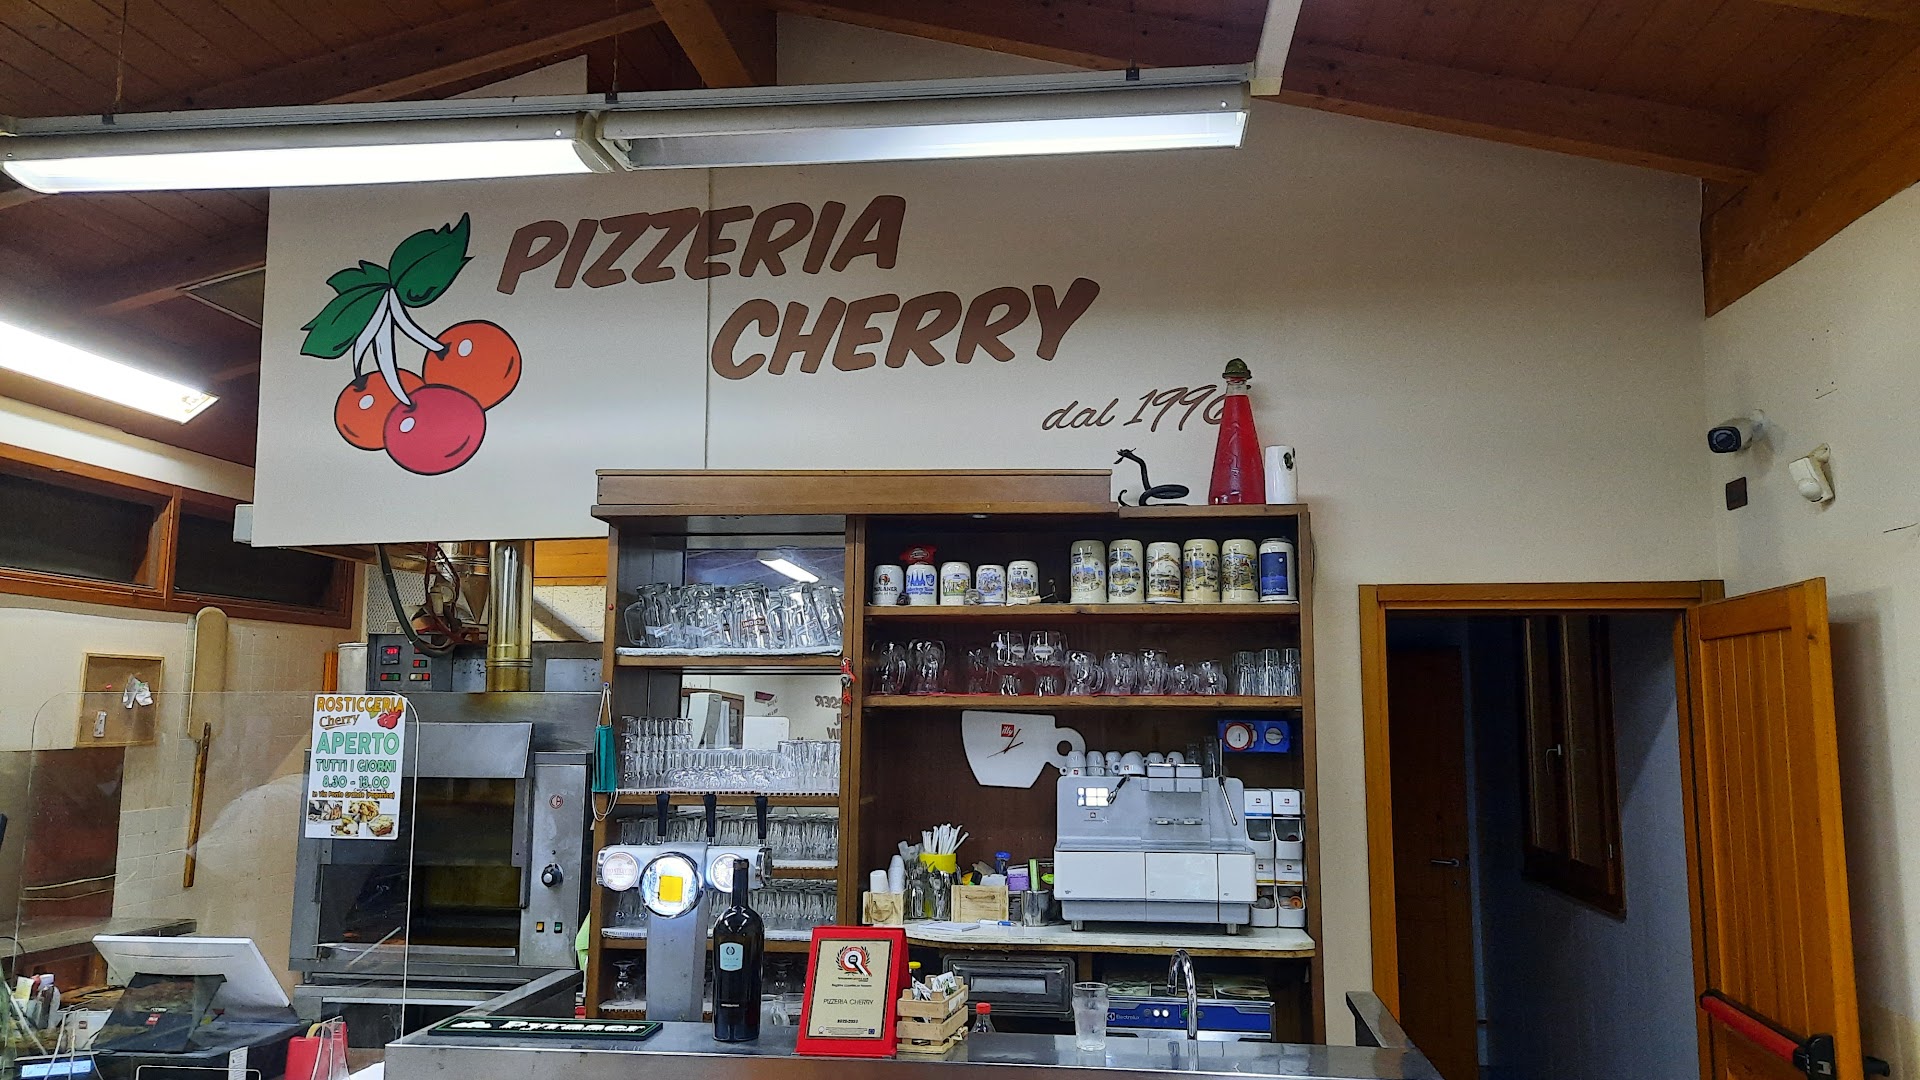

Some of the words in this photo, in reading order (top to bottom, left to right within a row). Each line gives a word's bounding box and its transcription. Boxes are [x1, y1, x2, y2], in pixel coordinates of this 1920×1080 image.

[497, 195, 906, 295] PIZZERIA
[711, 277, 1100, 380] CHERRY
[1042, 400, 1117, 431] dal
[316, 696, 404, 712] ROSTICCERIA
[319, 714, 360, 730] Cherry
[1002, 725, 1014, 736] illy
[316, 732, 400, 755] APERTO
[316, 759, 347, 772] TUTTI
[357, 760, 397, 772] GIORNI
